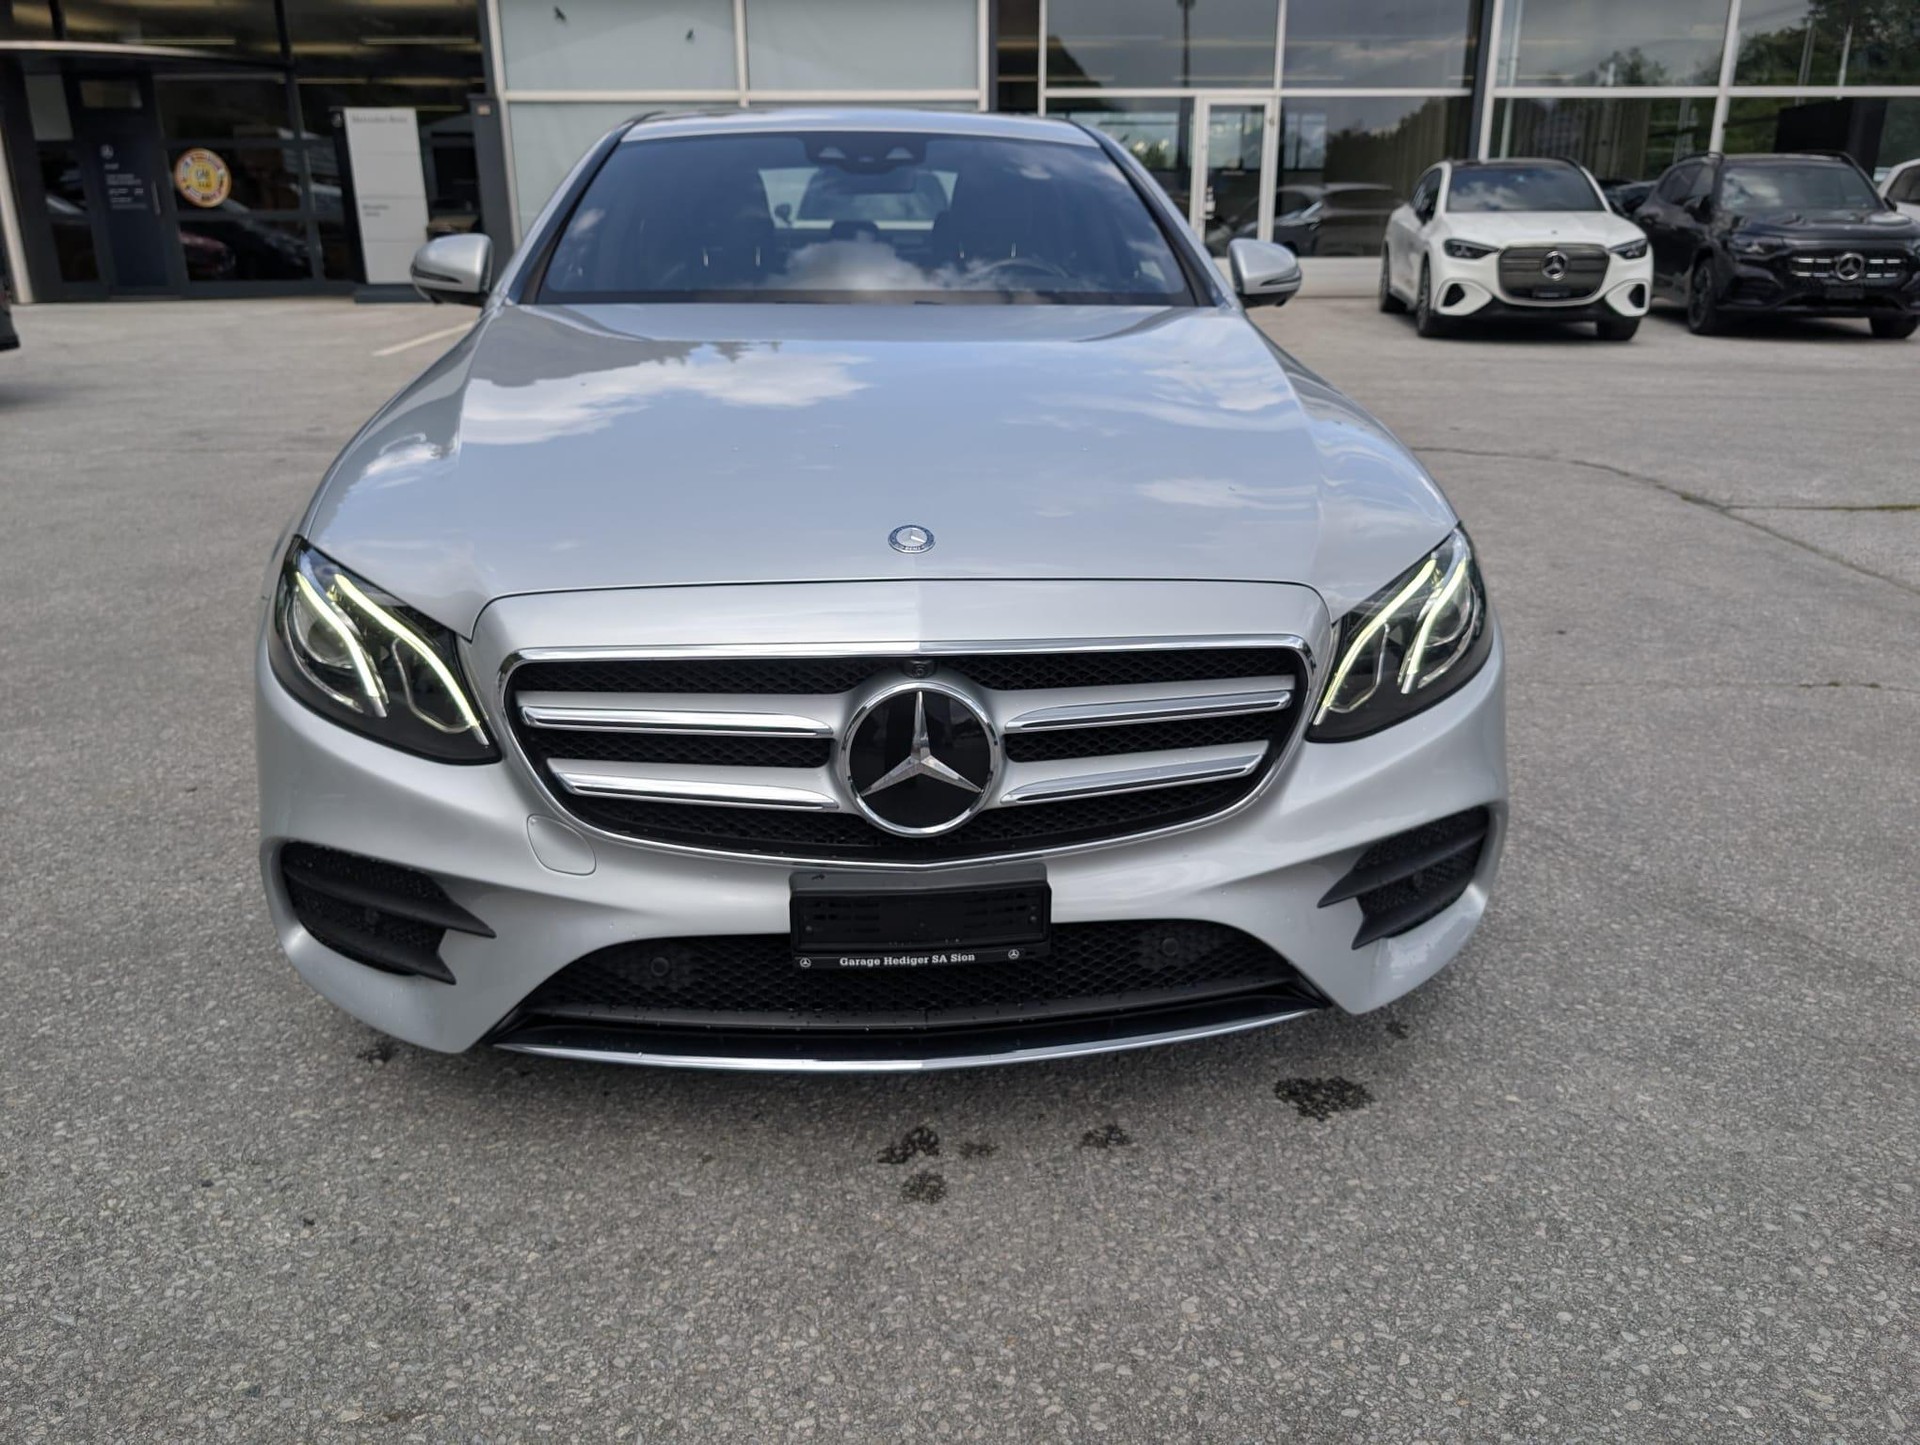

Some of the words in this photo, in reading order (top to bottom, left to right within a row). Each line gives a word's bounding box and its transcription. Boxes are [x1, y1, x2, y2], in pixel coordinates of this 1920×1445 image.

[840, 957, 880, 967] Garage
[883, 955, 930, 966] Hediger
[931, 954, 948, 963] SA
[950, 953, 975, 962] Sion
